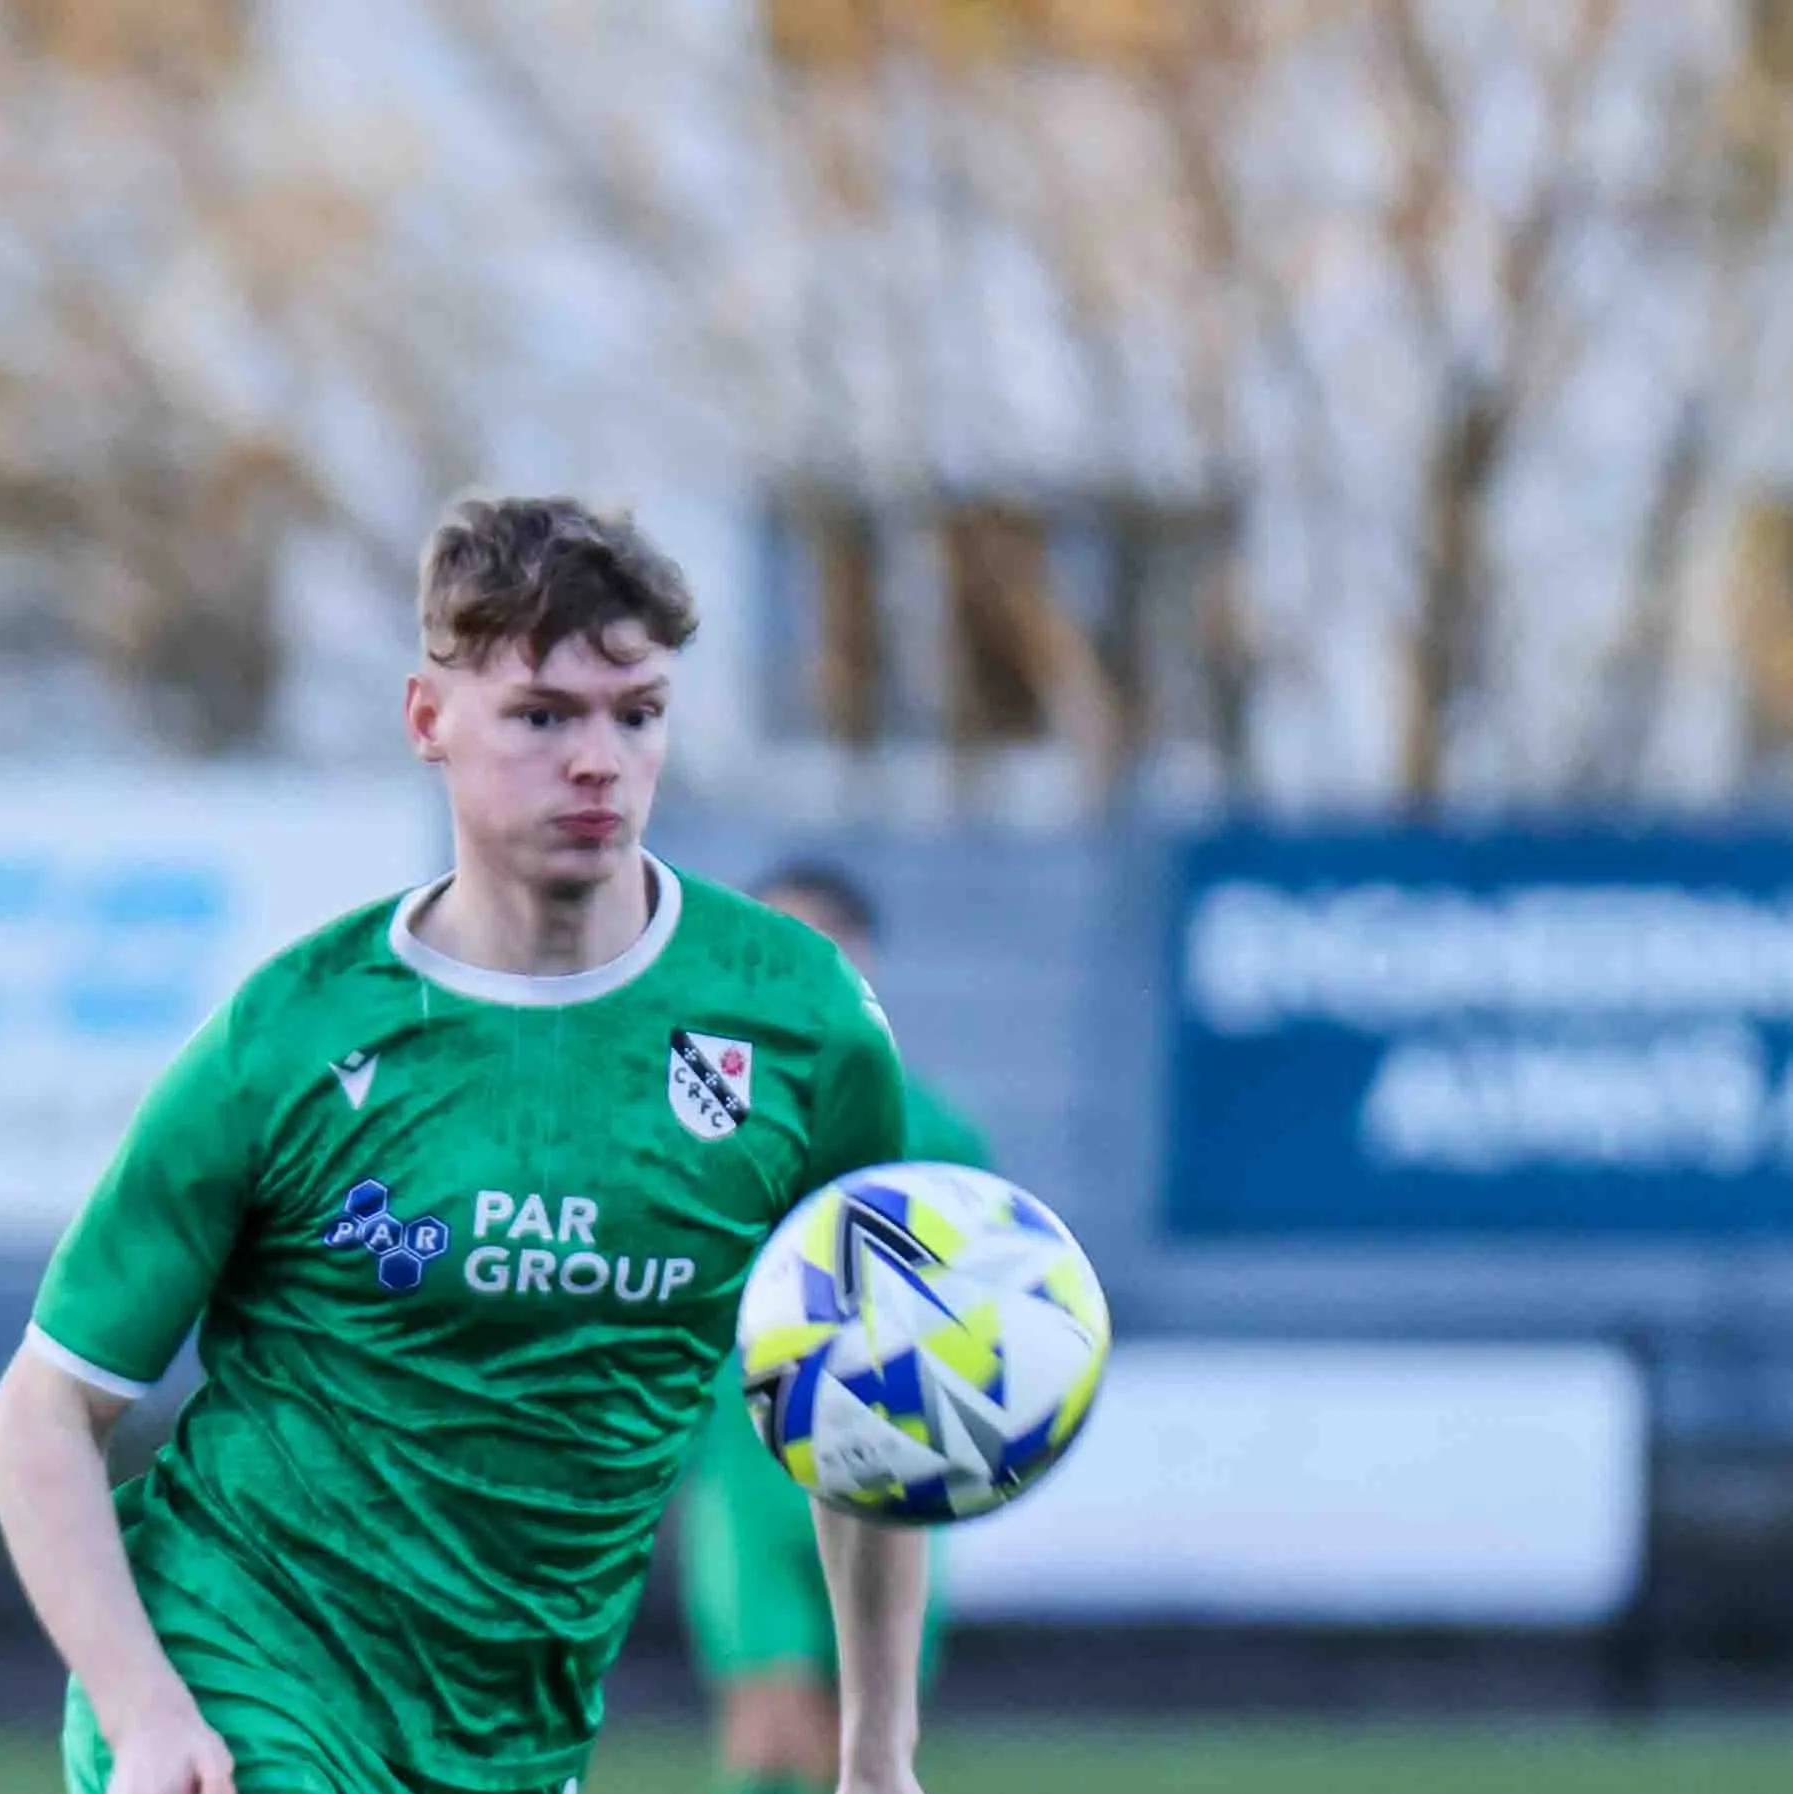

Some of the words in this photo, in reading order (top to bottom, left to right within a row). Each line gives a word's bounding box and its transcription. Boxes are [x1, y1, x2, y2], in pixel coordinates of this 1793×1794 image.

[674, 1066, 724, 1129] CRFC
[332, 1221, 437, 1251] PAR
[473, 1190, 599, 1245] PAR
[464, 1246, 697, 1302] GROUP
